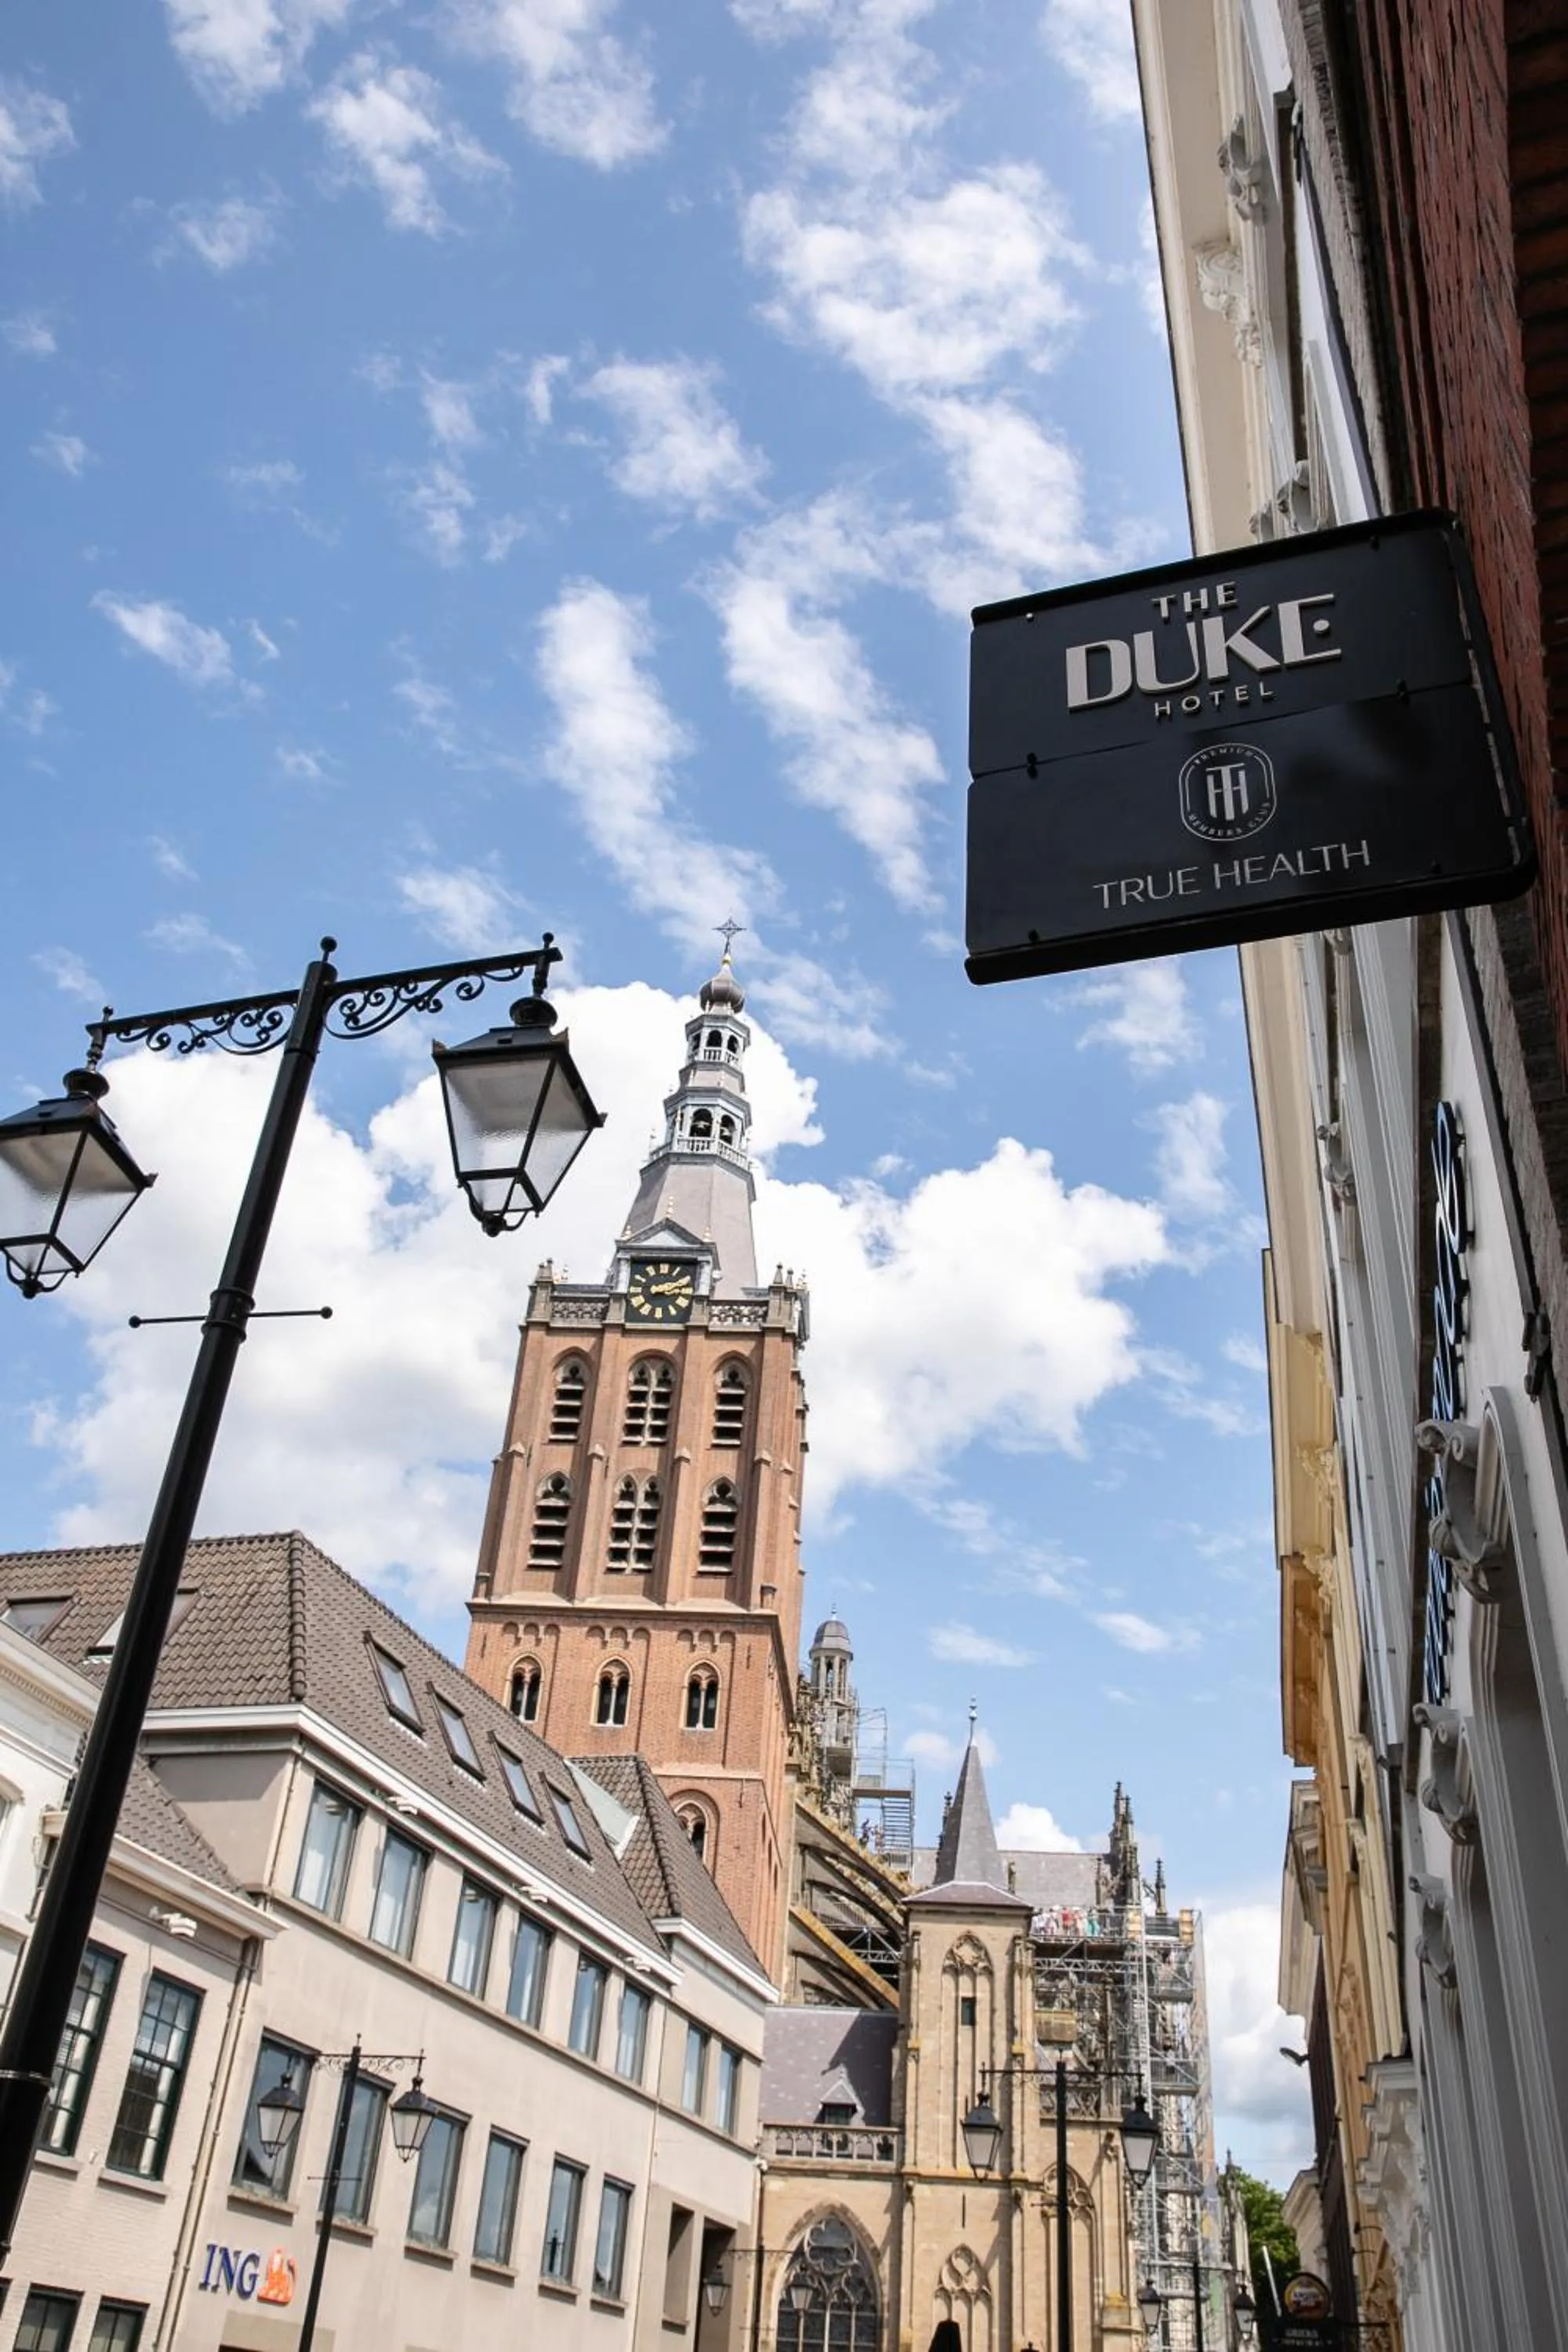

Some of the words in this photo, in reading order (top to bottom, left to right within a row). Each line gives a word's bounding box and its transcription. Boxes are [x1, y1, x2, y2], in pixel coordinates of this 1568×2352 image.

[1152, 581, 1238, 620] THE
[1066, 593, 1342, 710] DUKE
[1154, 681, 1274, 717] HOTEL
[1093, 866, 1201, 909] TRUE
[1214, 840, 1370, 890] HEALTH
[198, 2243, 260, 2301] ING
